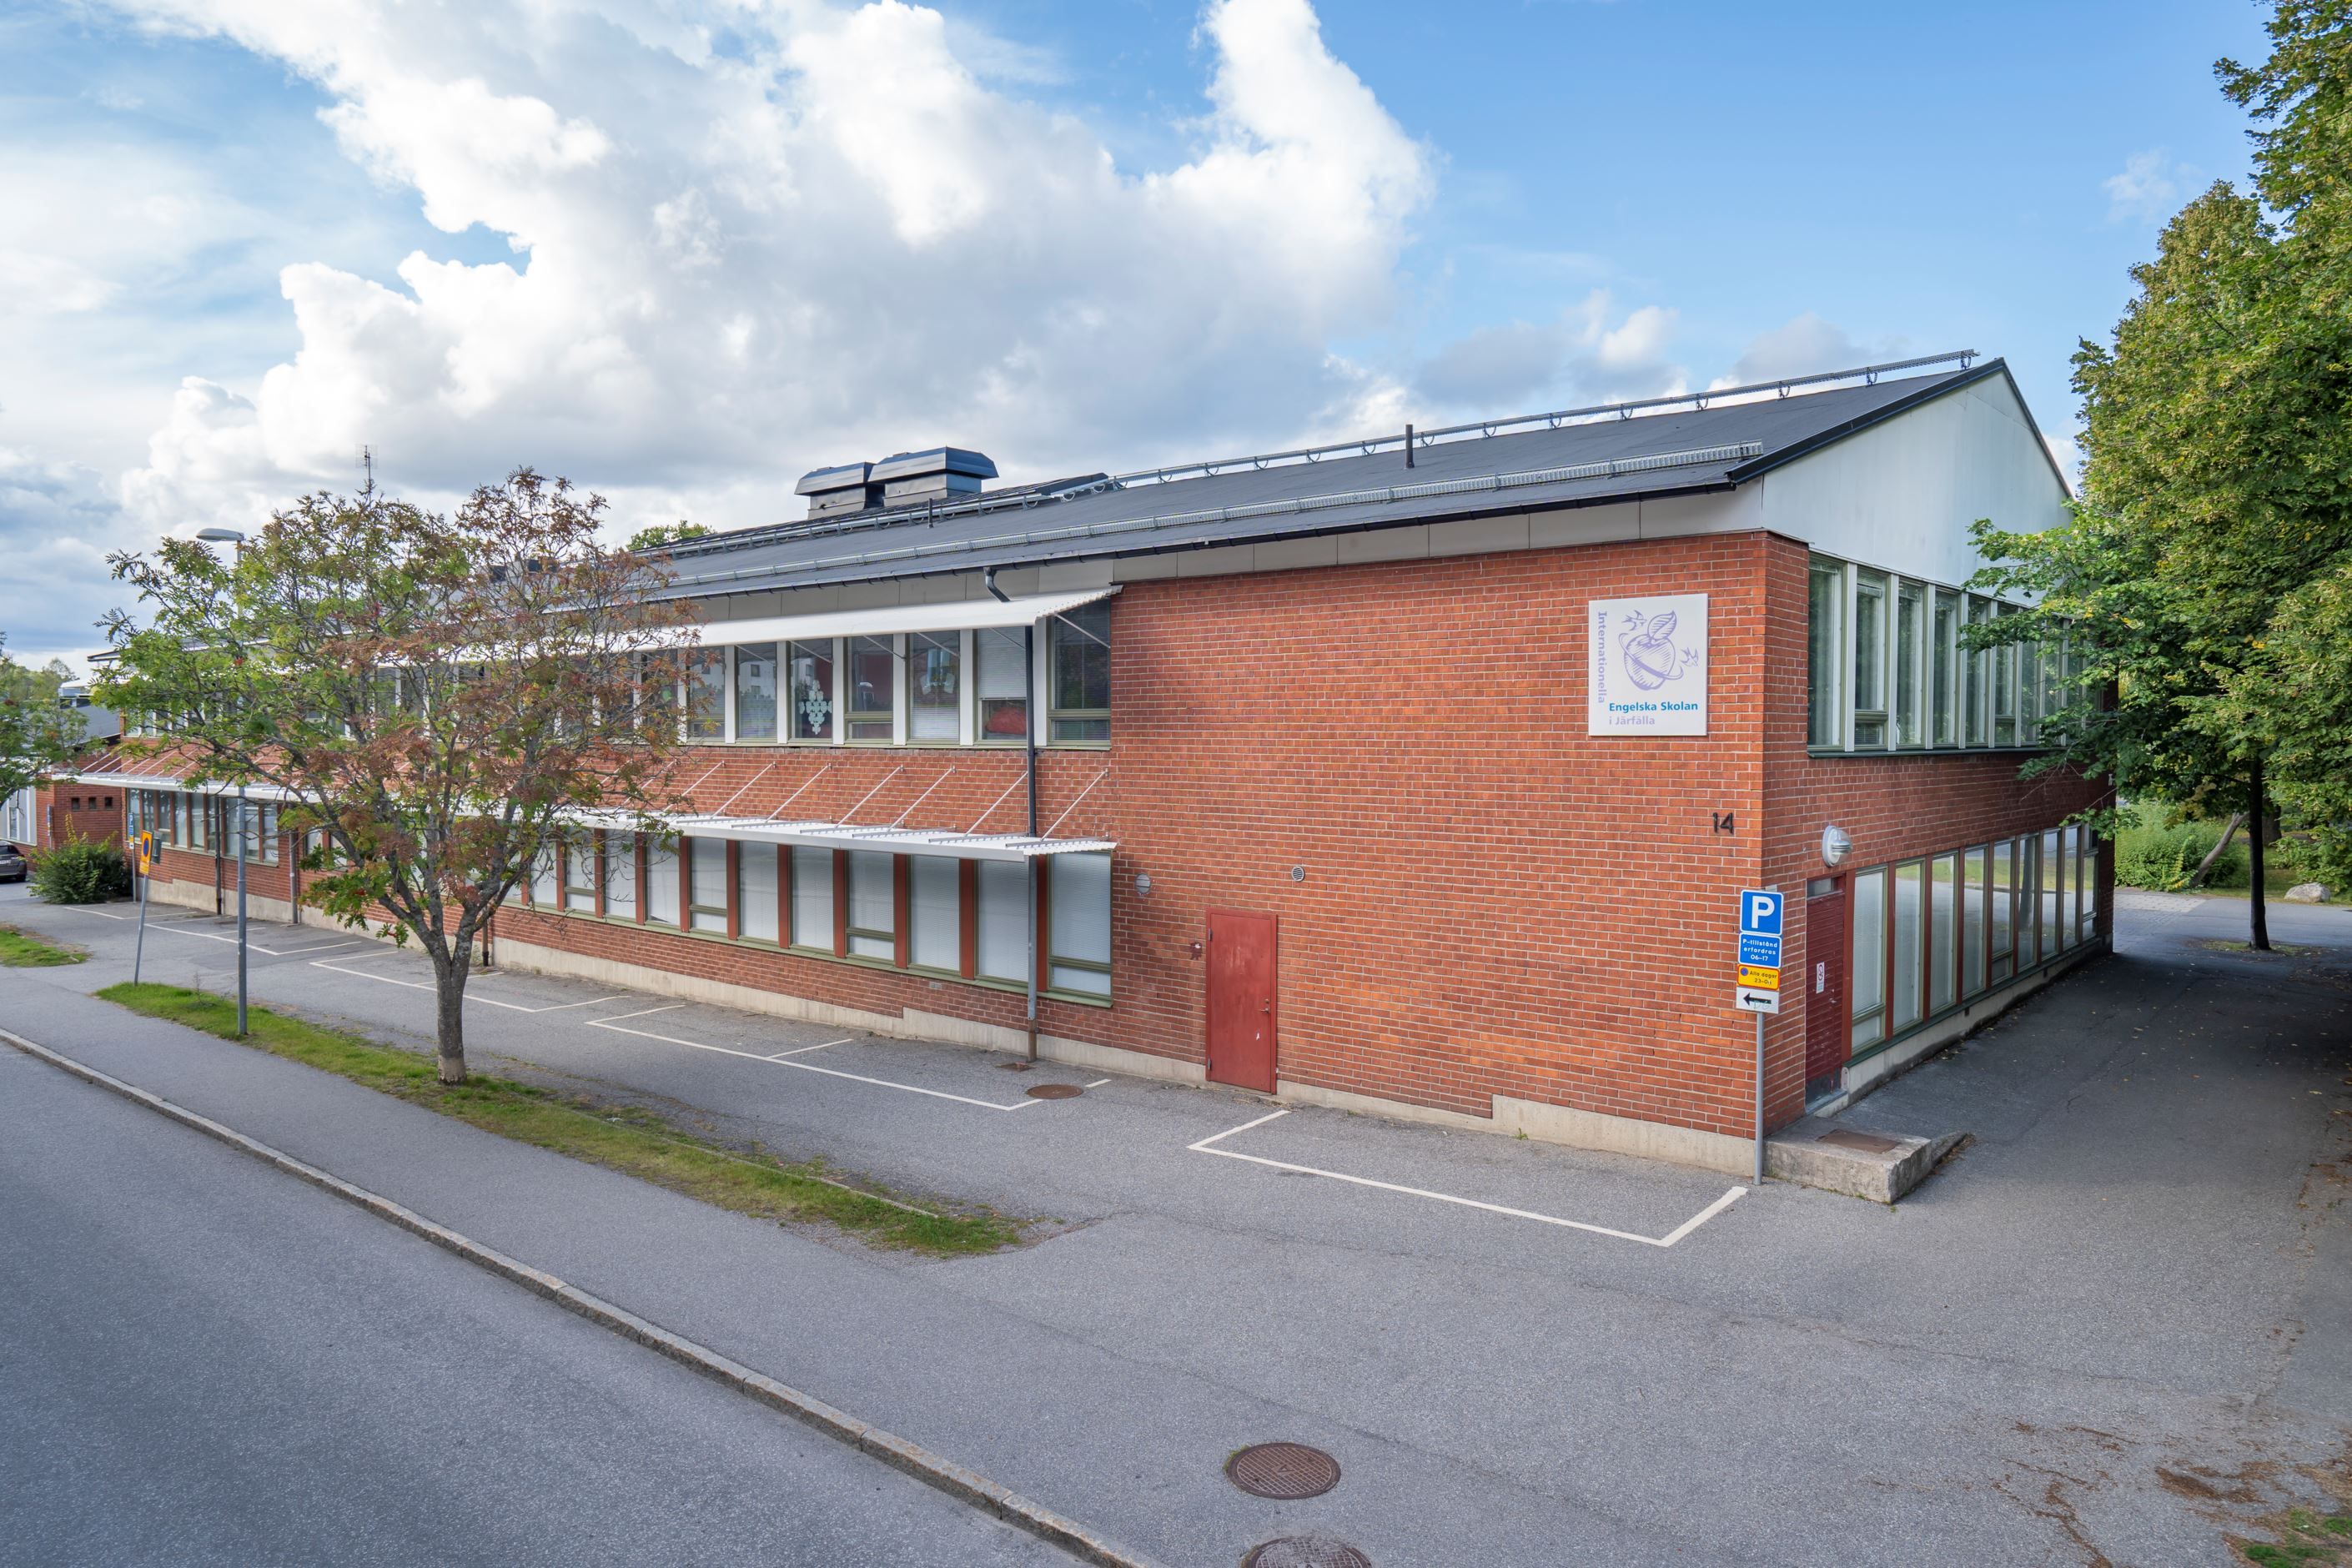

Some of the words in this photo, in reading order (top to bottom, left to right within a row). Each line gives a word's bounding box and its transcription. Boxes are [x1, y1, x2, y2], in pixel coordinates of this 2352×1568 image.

[1598, 611, 1607, 703] Internationella
[1609, 702, 1657, 713] Engelska
[1661, 701, 1698, 711] Skolan
[1609, 716, 1612, 725] i
[1616, 716, 1656, 725] Järfälla
[1712, 812, 1734, 834] 14
[1751, 896, 1775, 928] P
[1742, 938, 1778, 948] P-tillstånd
[1743, 947, 1777, 955] erfordras
